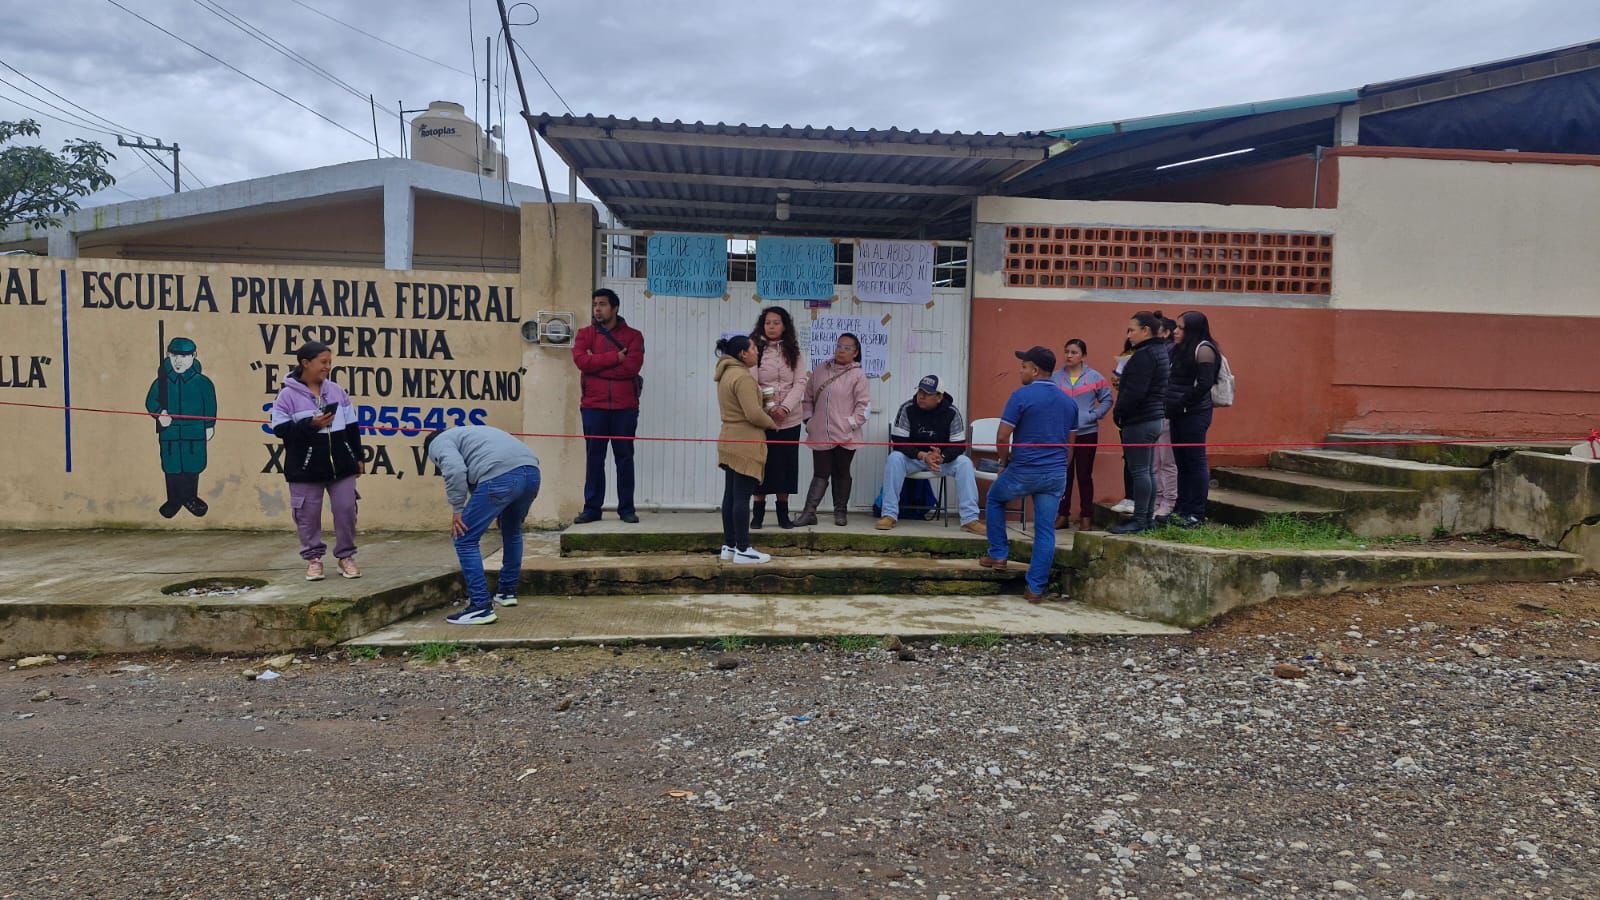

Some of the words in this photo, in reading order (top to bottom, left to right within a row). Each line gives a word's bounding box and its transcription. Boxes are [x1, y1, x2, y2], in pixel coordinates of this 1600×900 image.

[420, 125, 456, 138] Rotoplas
[670, 237, 689, 256] PIDE
[873, 244, 885, 260] AL
[857, 261, 914, 280] AUTORIDAD
[82, 270, 219, 312] ESCUELA
[231, 276, 386, 318] PRIMARIA
[395, 281, 521, 323] FEDERAL
[857, 280, 913, 296] PREFERENCIAS
[402, 366, 527, 402] MEXICANO"
